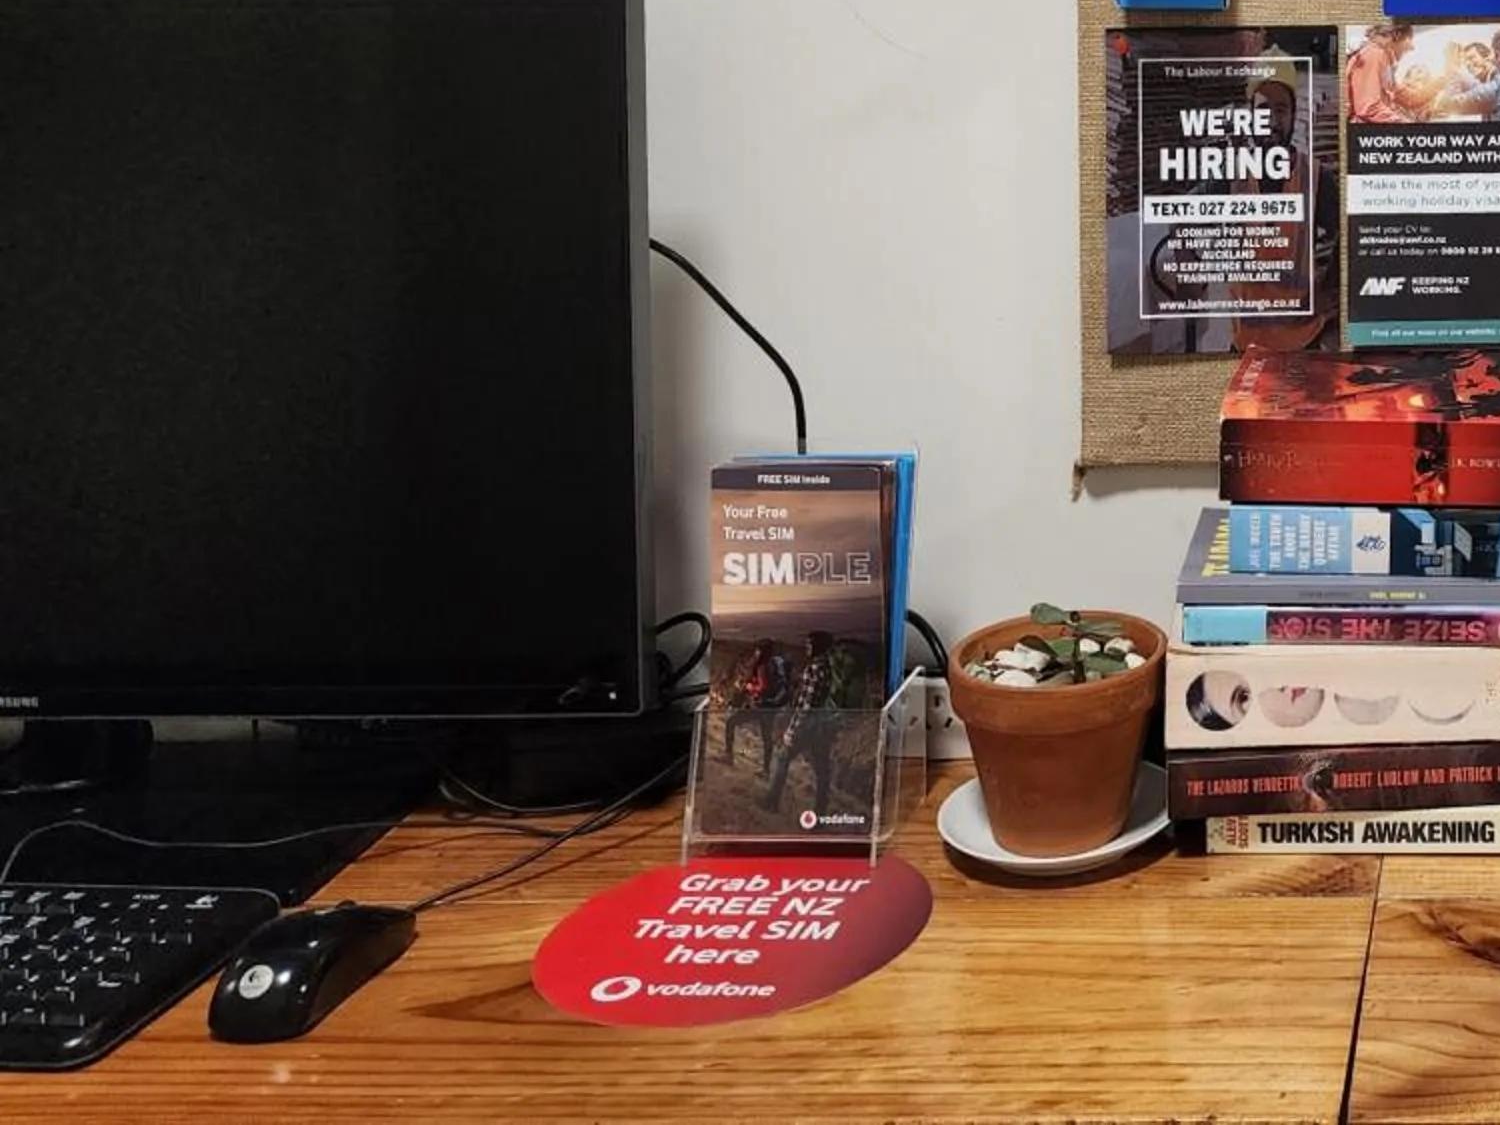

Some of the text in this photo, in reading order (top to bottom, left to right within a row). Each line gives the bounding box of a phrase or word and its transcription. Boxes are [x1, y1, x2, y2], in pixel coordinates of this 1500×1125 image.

[1165, 67, 1276, 78] The Labour Exchange
[1180, 109, 1271, 137] WE'RE
[1359, 136, 1403, 148] WORK
[1407, 136, 1446, 147] YOUR
[1450, 136, 1484, 147] WAY
[1160, 147, 1291, 181] HIRING
[1359, 153, 1392, 164] NEW
[1396, 152, 1462, 164] ZEALAND
[1152, 201, 1296, 216] TEXT: 027 224 9675
[1362, 195, 1417, 207] working
[1421, 194, 1470, 208] holiday
[757, 475, 830, 484] FREE SIM inside
[723, 505, 788, 518] Your Free
[723, 527, 794, 540] Travel SIM
[723, 552, 871, 585] SIMPLE
[1403, 620, 1487, 641] SEIZE
[1449, 767, 1492, 783] PATRICK
[819, 813, 865, 825] vodafone
[1257, 821, 1495, 845] TURKISH AWAKENING
[679, 874, 871, 896] Grab your
[668, 897, 844, 916] FREE NZ
[634, 920, 840, 940] Travel SIM
[664, 945, 761, 964] here
[646, 981, 776, 996] vodafone
